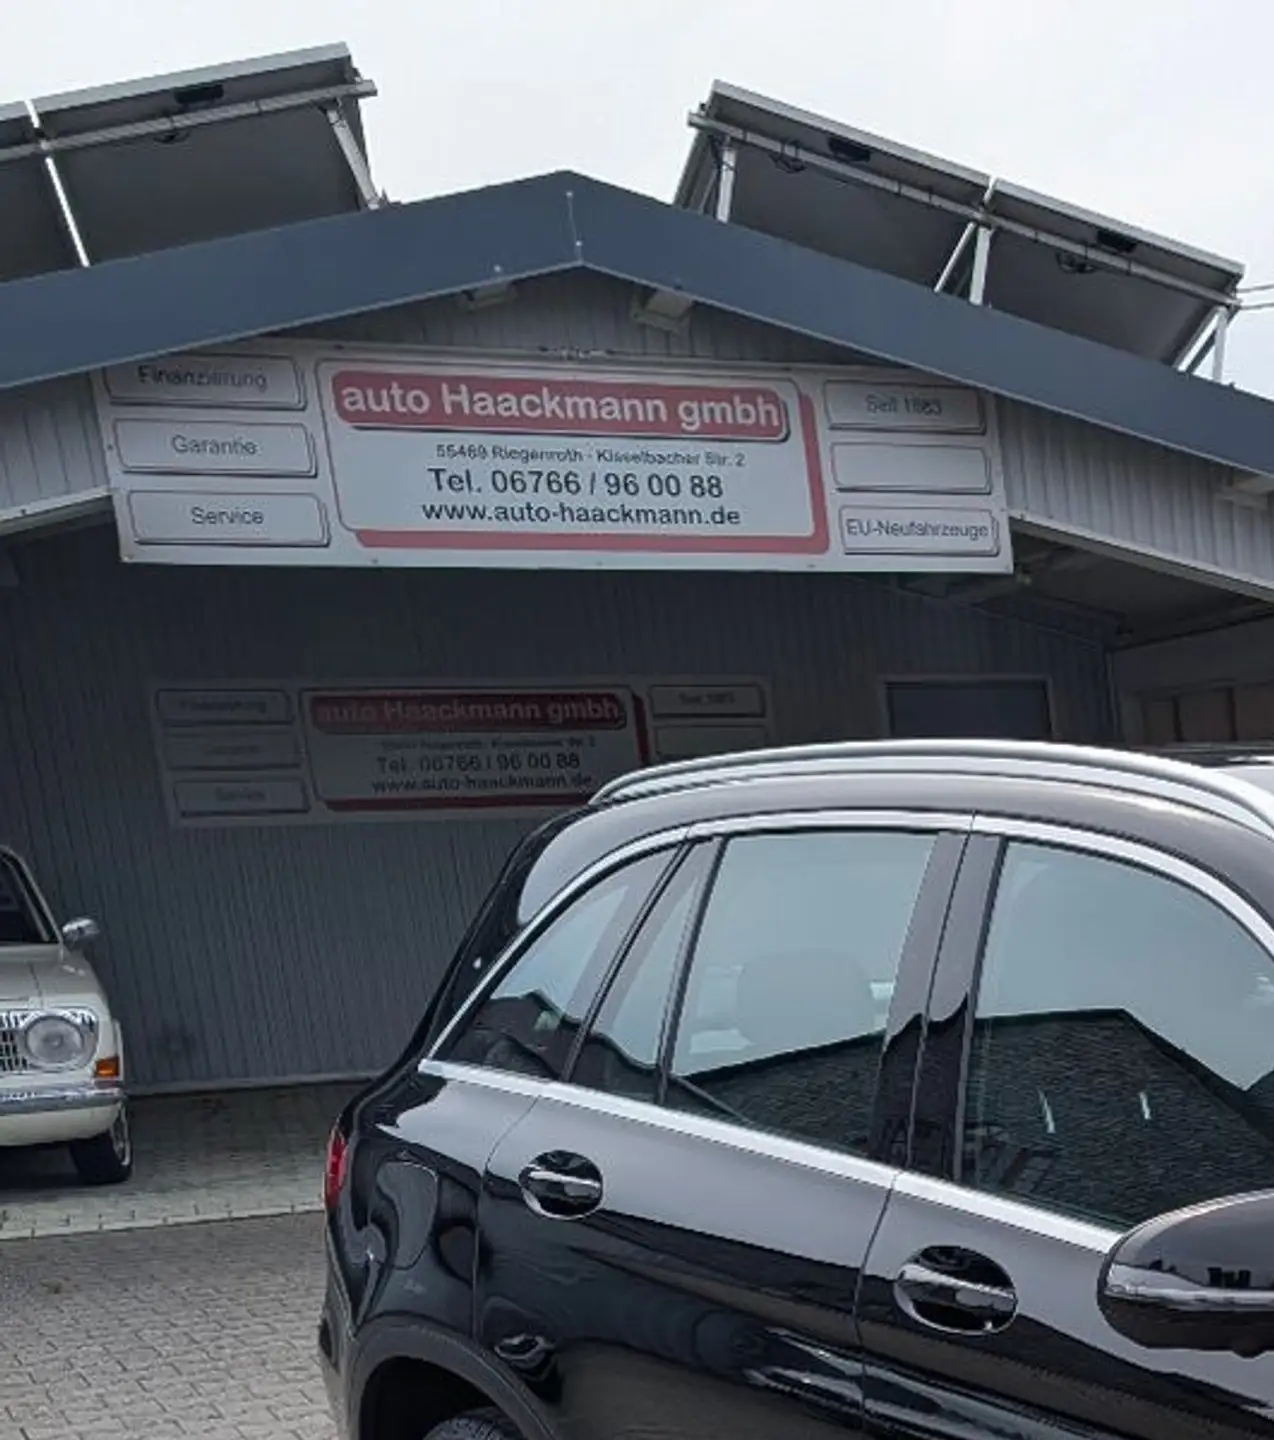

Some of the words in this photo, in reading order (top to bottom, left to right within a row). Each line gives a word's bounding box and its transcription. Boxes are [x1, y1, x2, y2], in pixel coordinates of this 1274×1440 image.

[341, 381, 431, 414] auto
[441, 382, 668, 423] Haackmann
[677, 394, 780, 432] gmbh
[171, 435, 259, 458] Garantie
[705, 450, 733, 466] Str.
[735, 452, 746, 467] 2
[426, 467, 482, 493] Tel.
[491, 470, 582, 495] 06766
[589, 471, 597, 495] /
[604, 472, 640, 496] 96
[647, 473, 681, 497] 00
[690, 474, 724, 498] 88
[191, 506, 265, 526] Service
[422, 500, 741, 525] www.auto-haackmann.de
[845, 517, 989, 541] EU-Neufahrzeuge
[383, 698, 541, 724] Haackmann
[546, 697, 619, 725] gmbh
